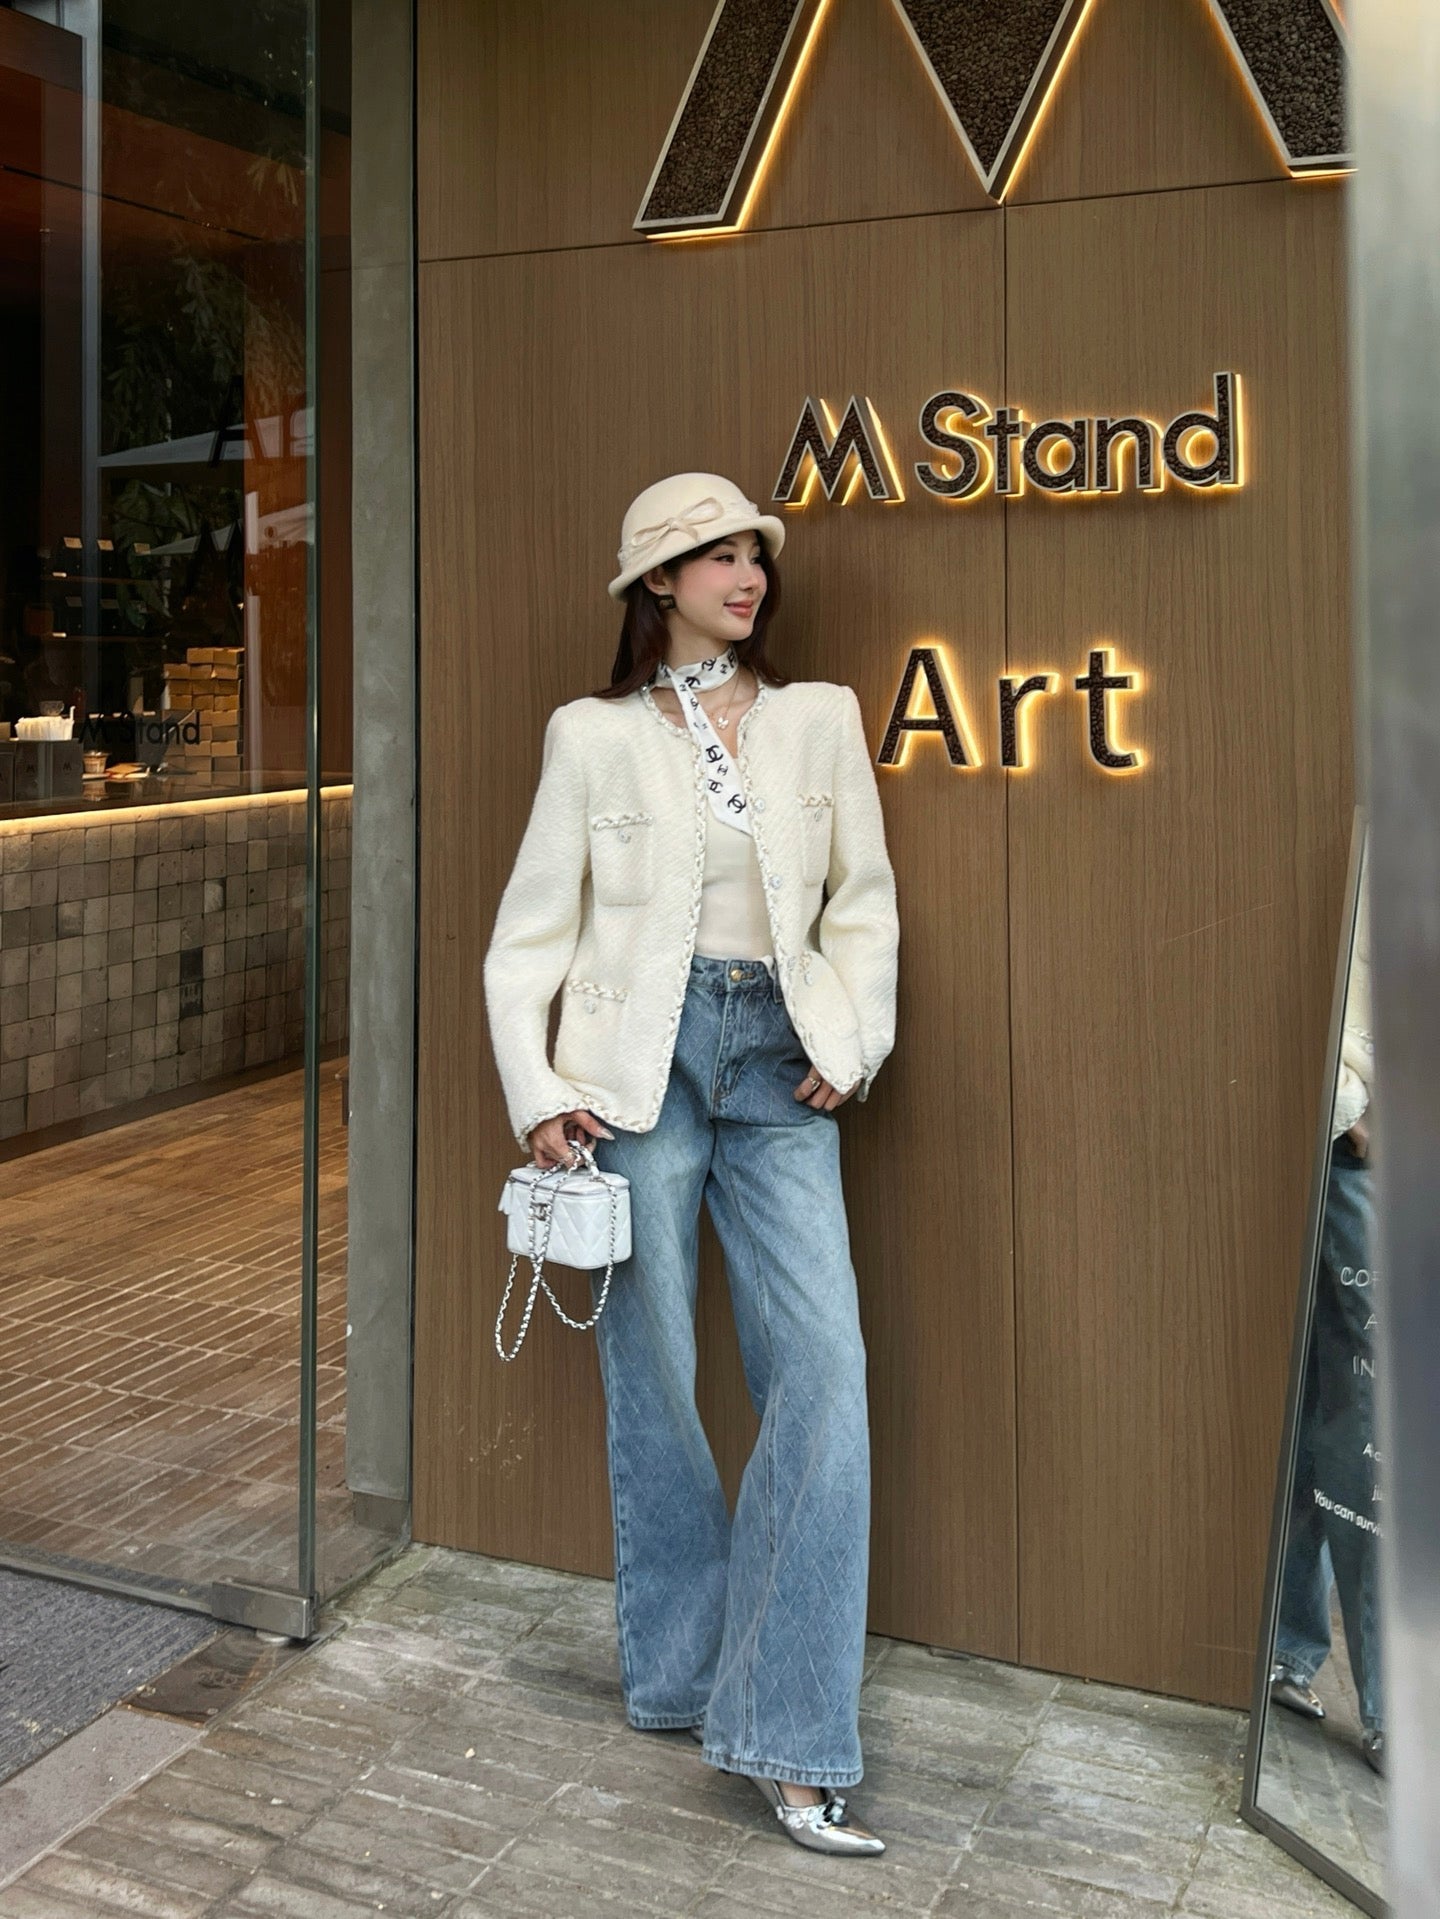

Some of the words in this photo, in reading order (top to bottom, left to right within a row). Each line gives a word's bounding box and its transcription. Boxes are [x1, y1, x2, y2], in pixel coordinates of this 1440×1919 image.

[772, 394, 904, 504] M
[914, 371, 1243, 500] Stand
[117, 711, 200, 745] Stand
[876, 644, 1145, 773] Art
[1313, 1488, 1334, 1511] You
[1333, 1503, 1356, 1522] can
